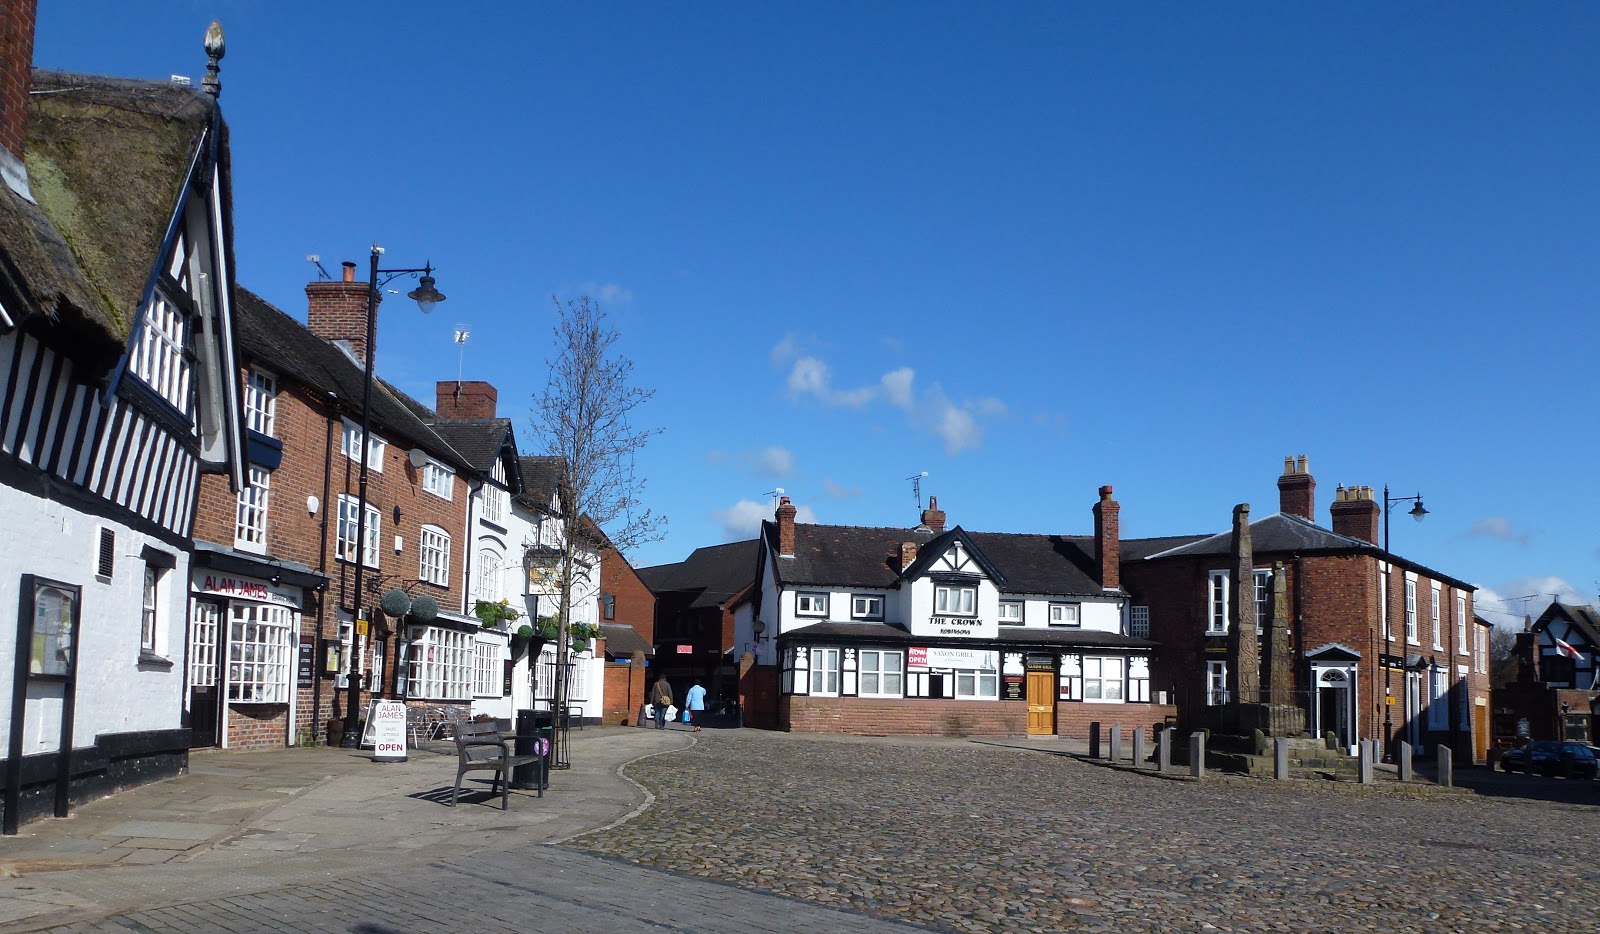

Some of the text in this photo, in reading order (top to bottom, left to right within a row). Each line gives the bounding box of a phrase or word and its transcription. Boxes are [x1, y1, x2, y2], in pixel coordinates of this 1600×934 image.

[204, 575, 236, 594] ALAN
[238, 580, 269, 600] JAMES
[928, 617, 983, 627] THE CROWN
[908, 656, 927, 664] OPEN
